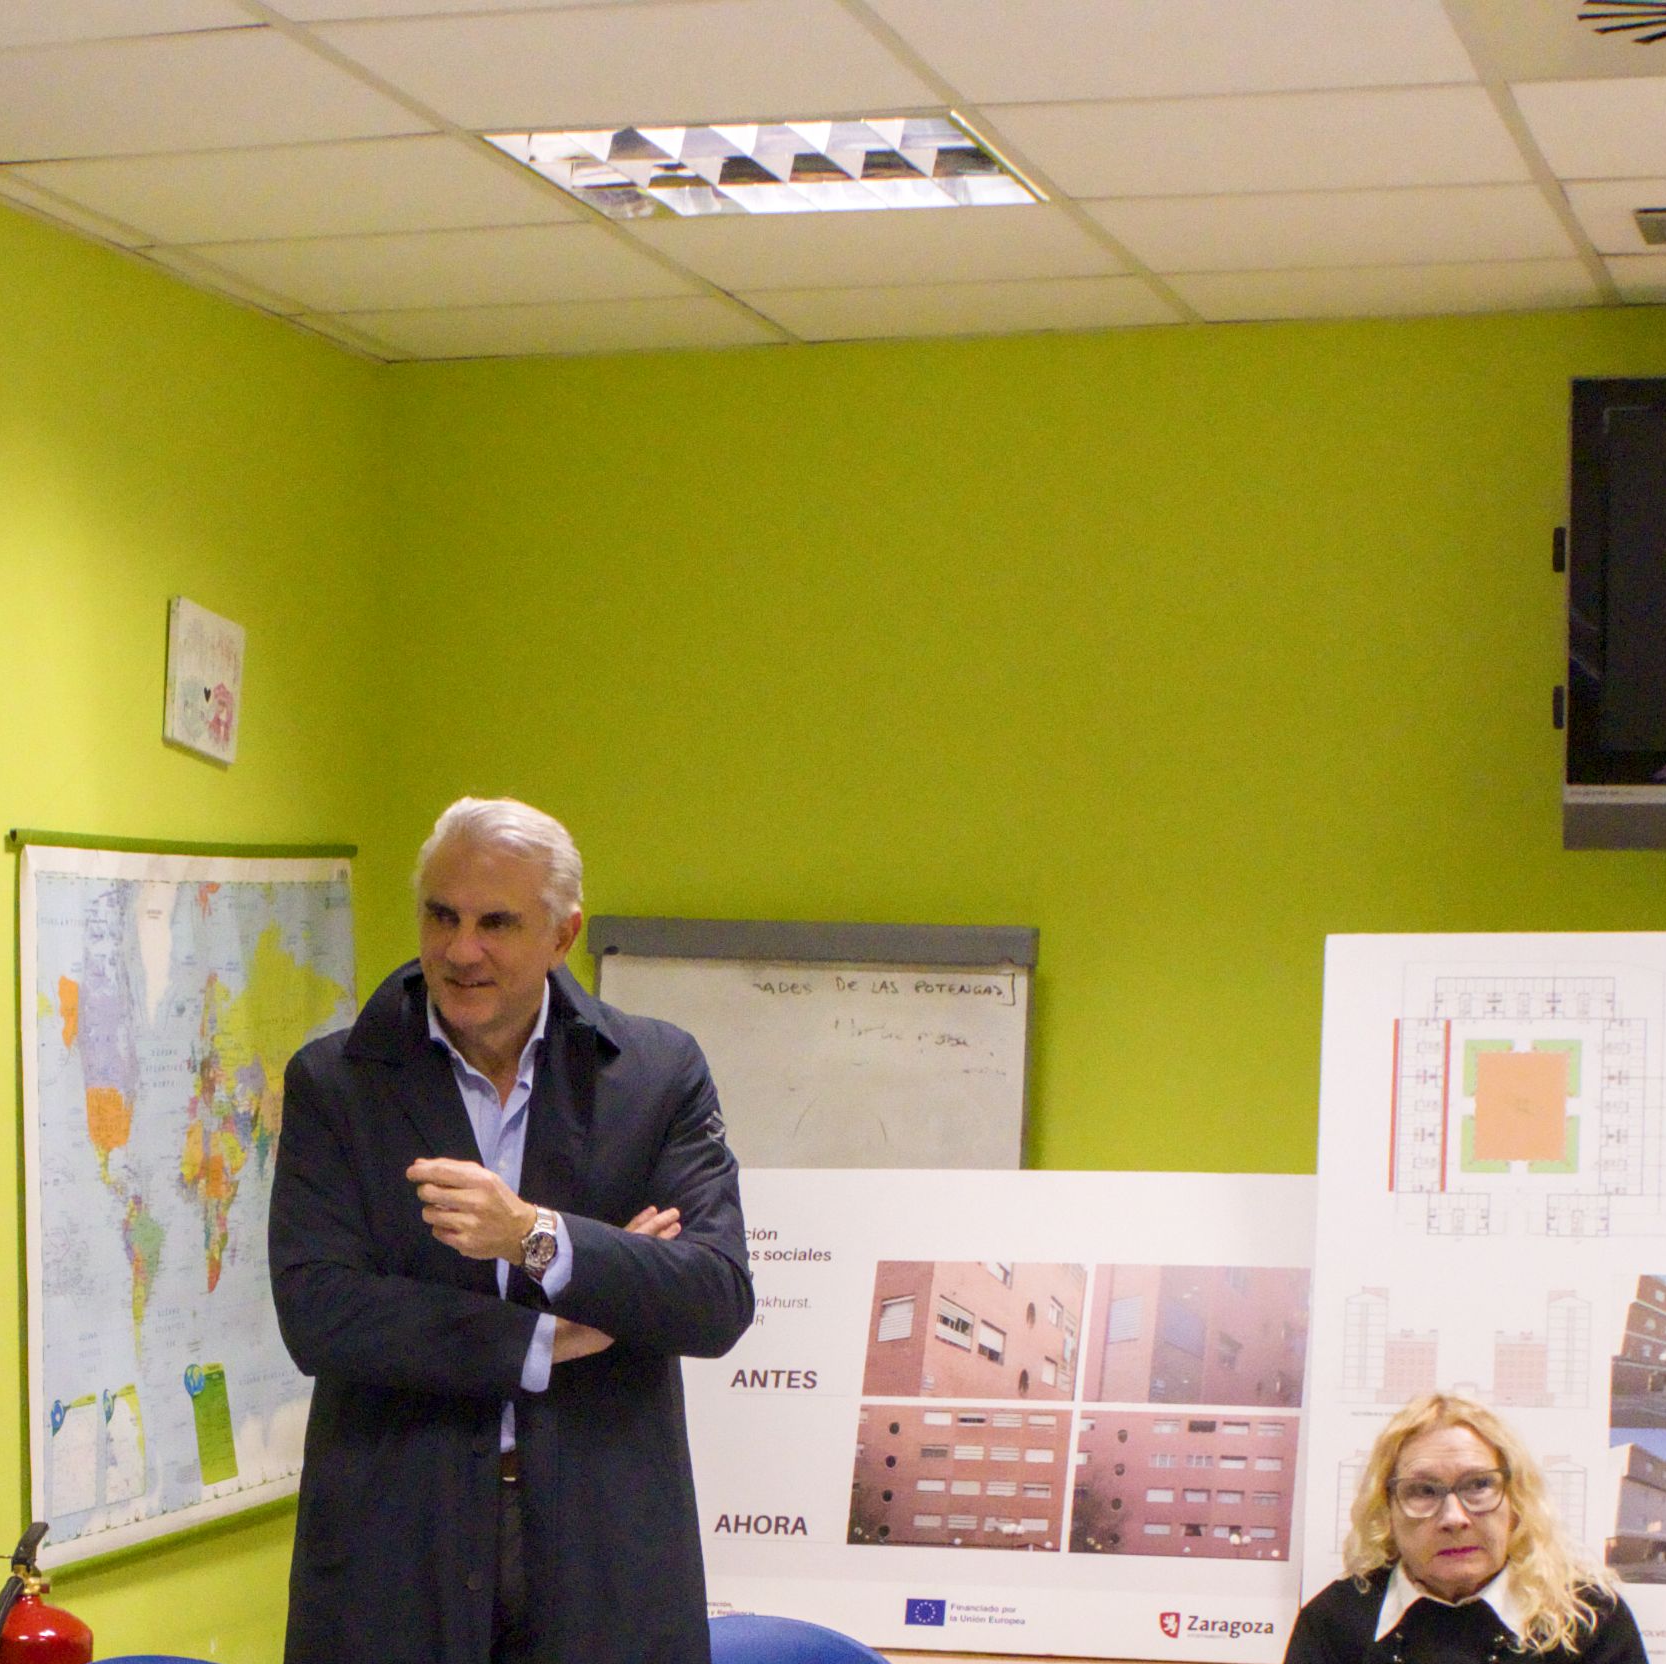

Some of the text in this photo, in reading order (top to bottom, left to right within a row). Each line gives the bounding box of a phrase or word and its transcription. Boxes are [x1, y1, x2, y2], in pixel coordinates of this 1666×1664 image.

[871, 980, 900, 995] LAS
[764, 1247, 832, 1262] sociales
[756, 1295, 812, 1309] nkhurst.
[730, 1369, 818, 1389] ANTES
[714, 1514, 808, 1536] AHORA
[950, 1602, 1016, 1615] Financiado por
[988, 1615, 1026, 1626] Europea
[1187, 1615, 1274, 1639] Zaragoza
